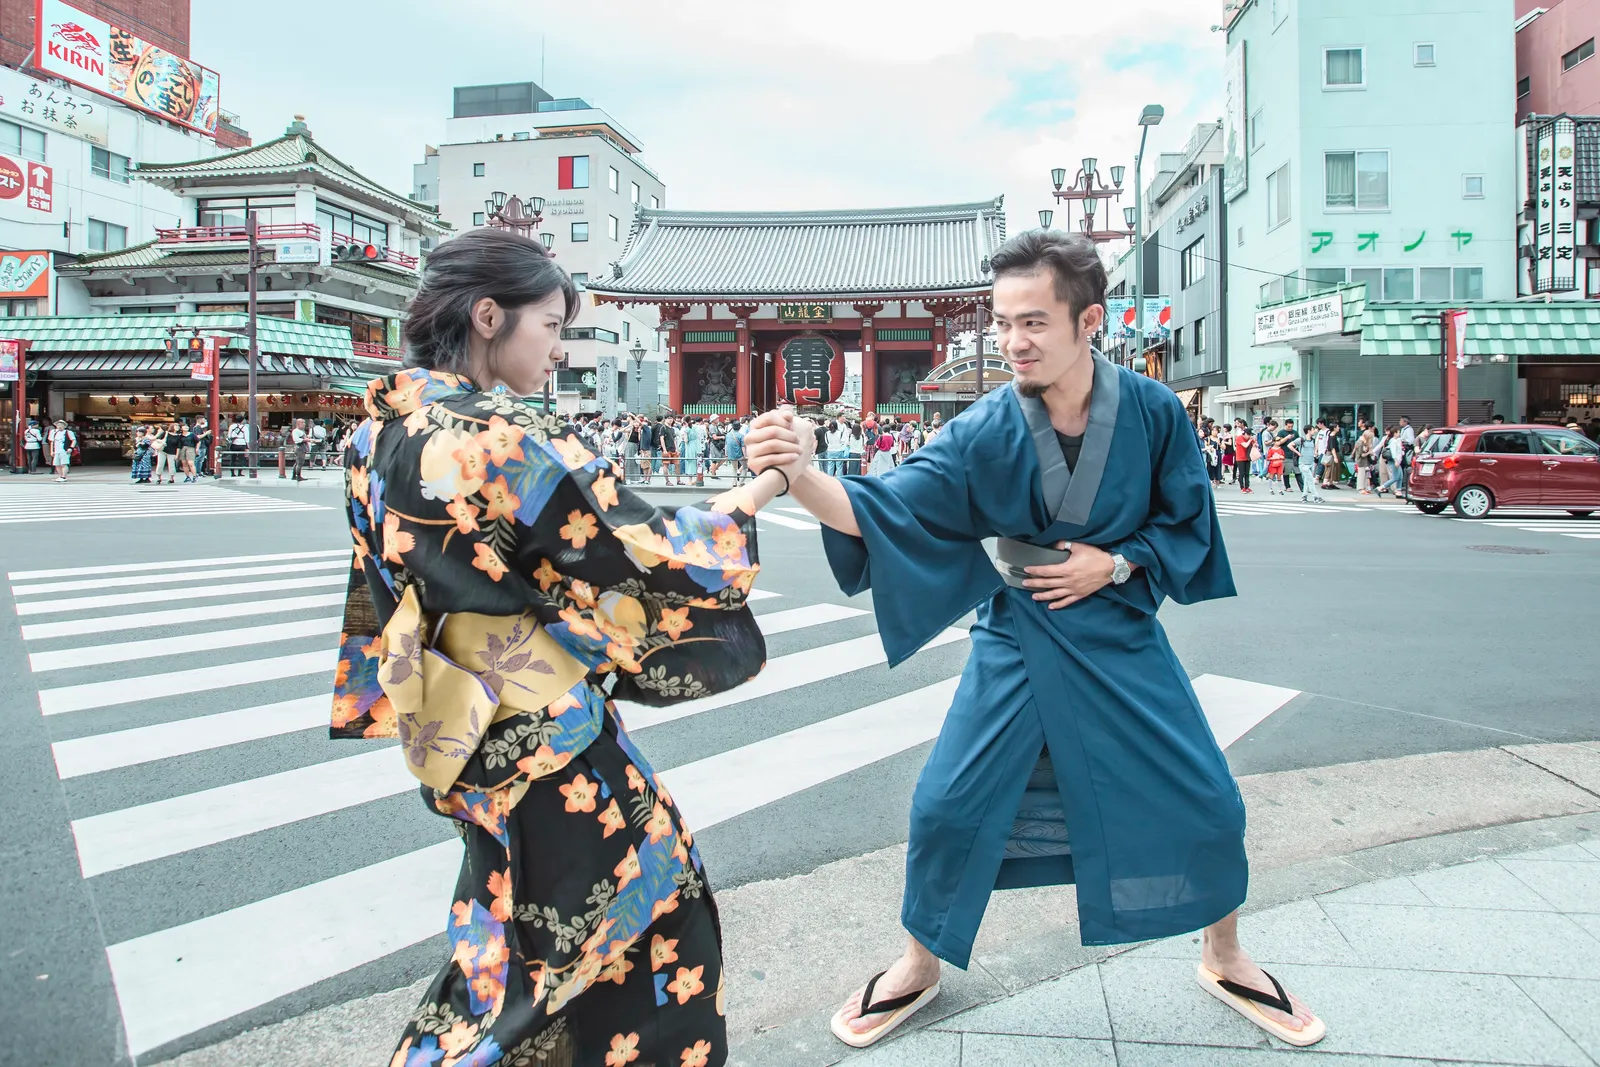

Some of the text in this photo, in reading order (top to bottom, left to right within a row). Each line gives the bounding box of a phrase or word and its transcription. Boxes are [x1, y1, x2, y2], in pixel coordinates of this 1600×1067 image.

[48, 41, 104, 77] KIRIN
[29, 83, 93, 114] あんみつ
[21, 99, 77, 129] お抹茶
[550, 207, 584, 216] Ryokan
[1311, 230, 1473, 254] アオノヤ
[1556, 222, 1573, 260] 三定
[1258, 314, 1275, 325] 地下鉄
[1288, 301, 1332, 319] 銀座線 浅草駅
[781, 338, 836, 404] 雷門
[1260, 362, 1292, 381] アオノヤ
